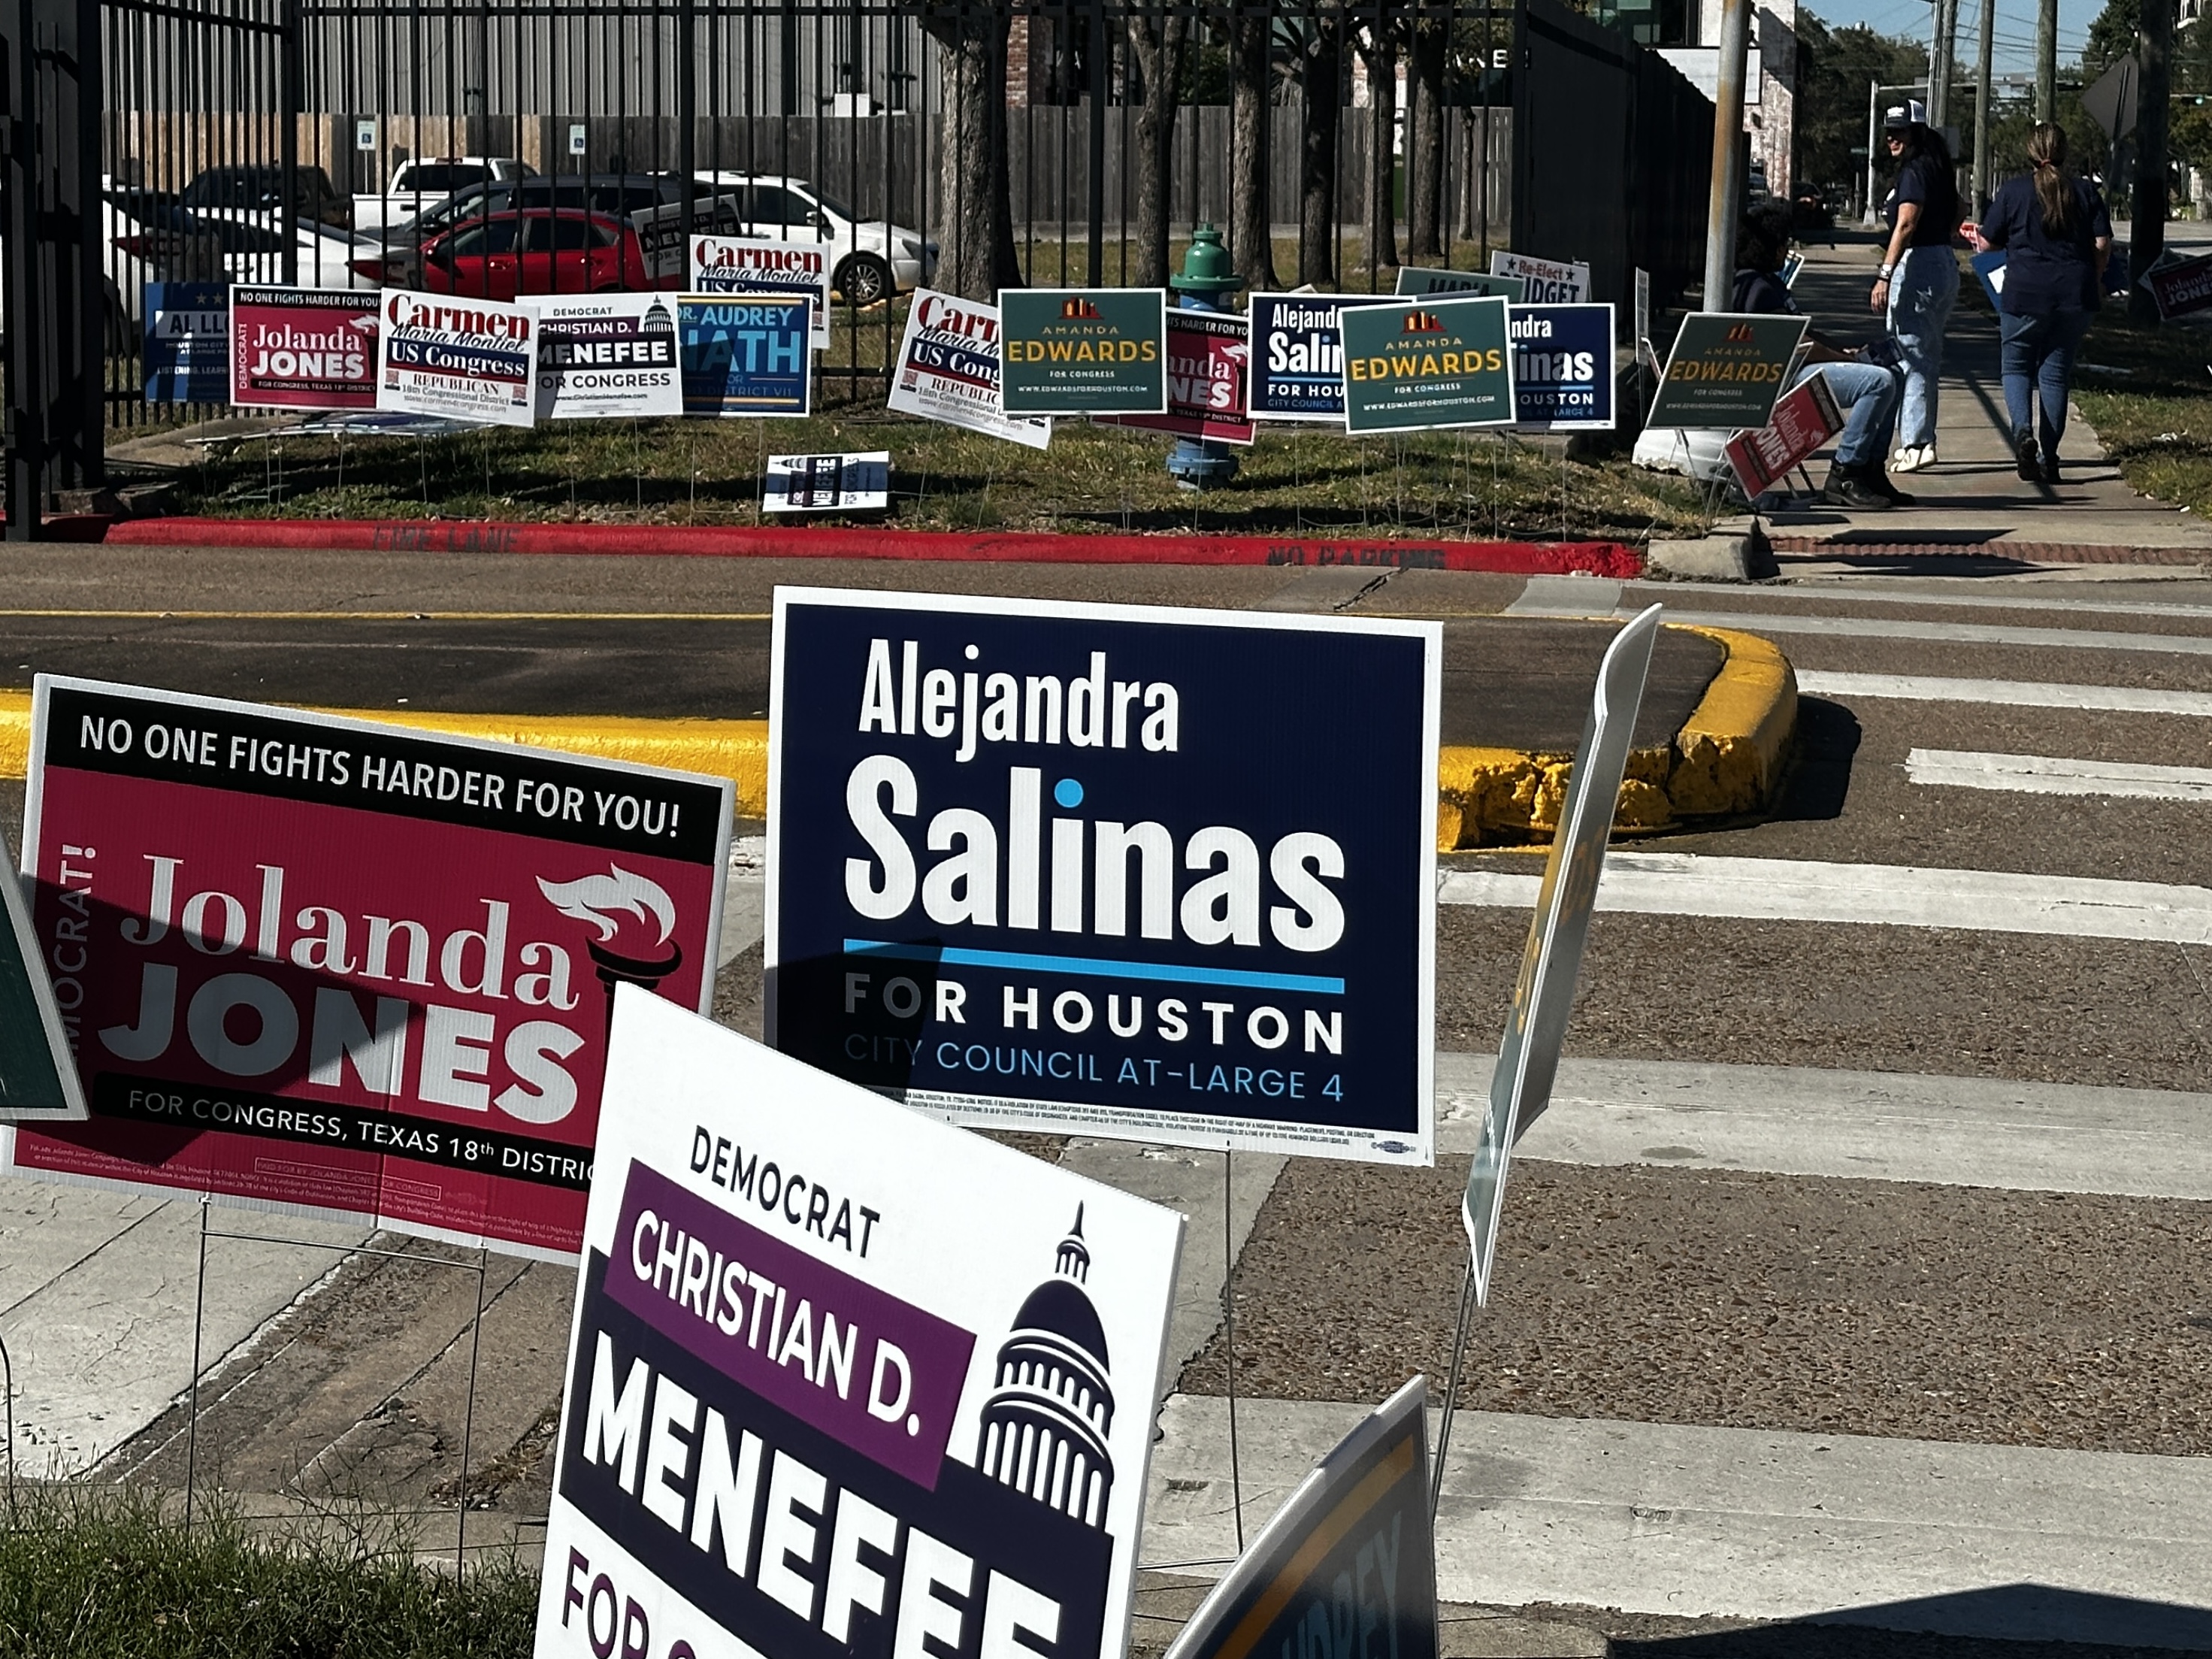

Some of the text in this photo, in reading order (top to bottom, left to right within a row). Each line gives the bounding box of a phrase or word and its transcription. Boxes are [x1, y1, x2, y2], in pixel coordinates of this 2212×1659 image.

[696, 239, 822, 273] Carmen
[700, 264, 819, 284] Maria Montiel
[1518, 260, 1563, 280] Re-Elect
[240, 292, 253, 302] NO
[255, 292, 273, 304] ONE
[274, 293, 304, 304] FIGHTS
[306, 295, 340, 305] HARDER
[342, 295, 359, 306] FOR
[1499, 271, 1580, 304] IDGET
[2168, 281, 2212, 306] JONE
[171, 314, 195, 333] AL
[388, 294, 530, 341] Carmen
[553, 307, 613, 316] DEMOCRAT
[701, 307, 794, 326] AUDREY
[253, 323, 362, 352] Jolanda
[392, 320, 525, 353] Maria Montiel
[538, 322, 632, 336] CHRISTIAN D.
[917, 325, 977, 351] Maria
[1042, 326, 1119, 335] AMANDA
[1182, 319, 1215, 331] HARDER
[1218, 322, 1235, 335] FOR
[1236, 326, 1248, 335] YO
[1511, 313, 1552, 338] ndra
[537, 341, 668, 365] MENEFEE
[680, 329, 801, 373] NATH
[1008, 341, 1156, 362] EDWARDS
[1385, 337, 1463, 350] AMANDA
[1705, 348, 1761, 356] AMANDA
[251, 350, 364, 380] JONES
[391, 341, 525, 376] US Congress
[913, 343, 1000, 389] US Cong
[1351, 349, 1502, 380] EDWARDS
[413, 374, 500, 395] REPUBLICAN
[537, 373, 670, 389] OR CONGRESS
[1669, 361, 1784, 383] EDWARDS
[422, 387, 478, 401] Congressional
[480, 394, 510, 406] District
[707, 386, 770, 396] DISTRICT
[931, 377, 1000, 405] REPUBLIC
[1168, 375, 1232, 408] NES
[1268, 384, 1344, 397] FOR HOU
[1394, 383, 1461, 394] FOR CONGRESS
[1520, 393, 1594, 405] OUSTON
[404, 395, 507, 413] www.carmen4congress.com
[940, 392, 997, 414] Congressional
[1291, 400, 1334, 408] COUNCIL
[1588, 407, 1594, 416] 4
[1752, 422, 1791, 471] ONES
[372, 524, 520, 553] FIRE LANE
[1267, 546, 1305, 565] NO
[858, 637, 1180, 763] Alejandra
[80, 714, 680, 838] NO ONE FIGHTS HARDER FOR YOU!
[844, 754, 1346, 953] Salinas
[120, 851, 581, 1013] Jolanda
[844, 971, 1344, 1055] FOR HOUSTON
[98, 961, 586, 1126] JONES
[844, 1032, 1345, 1103] CITY COUNCIL AT-LARGE 4
[128, 1088, 183, 1117] FOR
[192, 1097, 349, 1143] CONGRESS,
[357, 1119, 440, 1155] TEXAS
[449, 1137, 495, 1163] 18th
[689, 1125, 882, 1260] DEMOCRAT
[630, 1209, 921, 1438] CHRISTIAN D.
